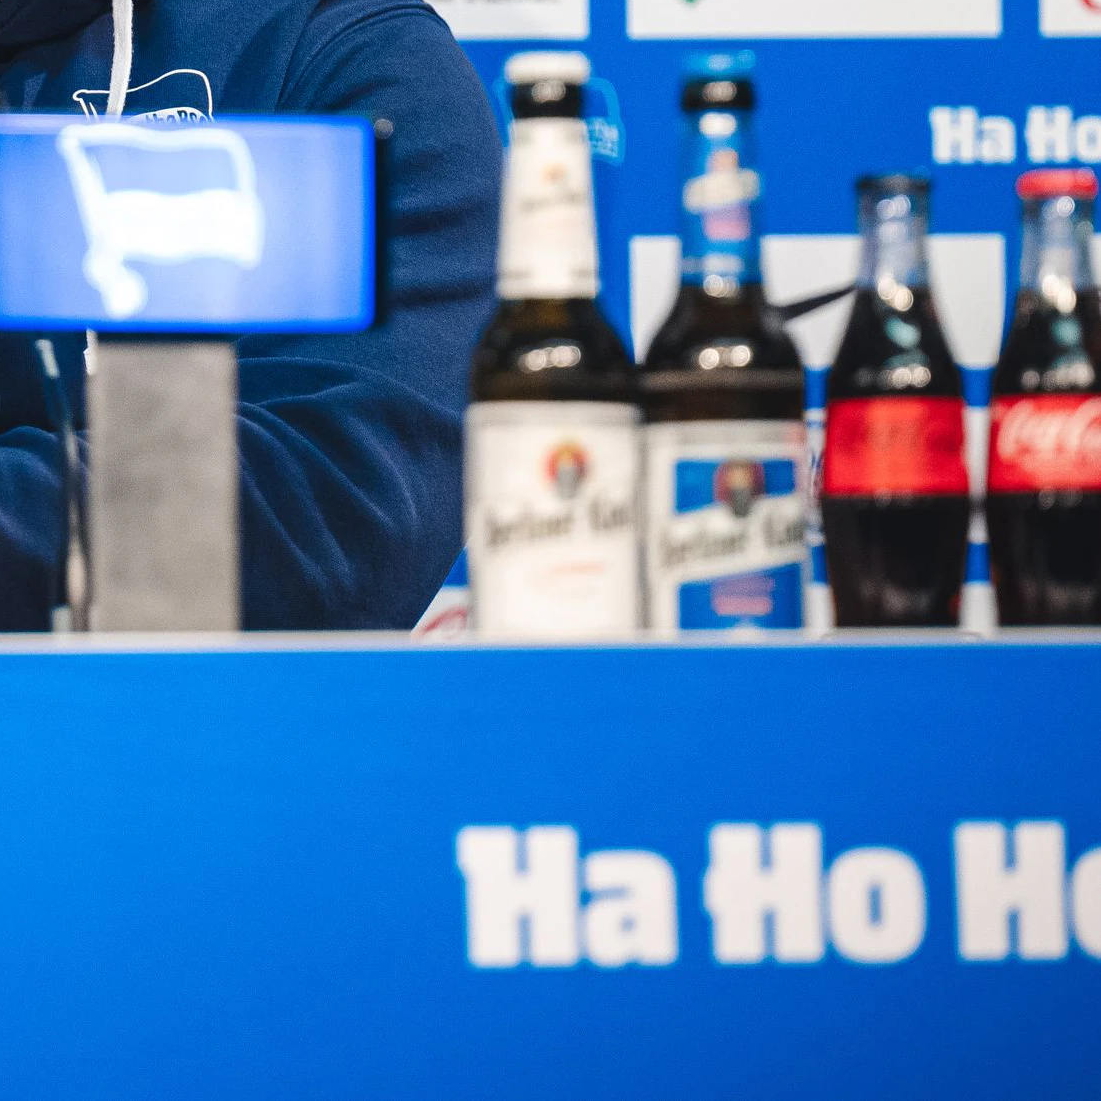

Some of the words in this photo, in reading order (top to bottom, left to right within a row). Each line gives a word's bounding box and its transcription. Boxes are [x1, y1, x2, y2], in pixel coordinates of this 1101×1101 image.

[929, 105, 1017, 164] Ha
[456, 825, 680, 967] Ha
[704, 821, 927, 965] Ho
